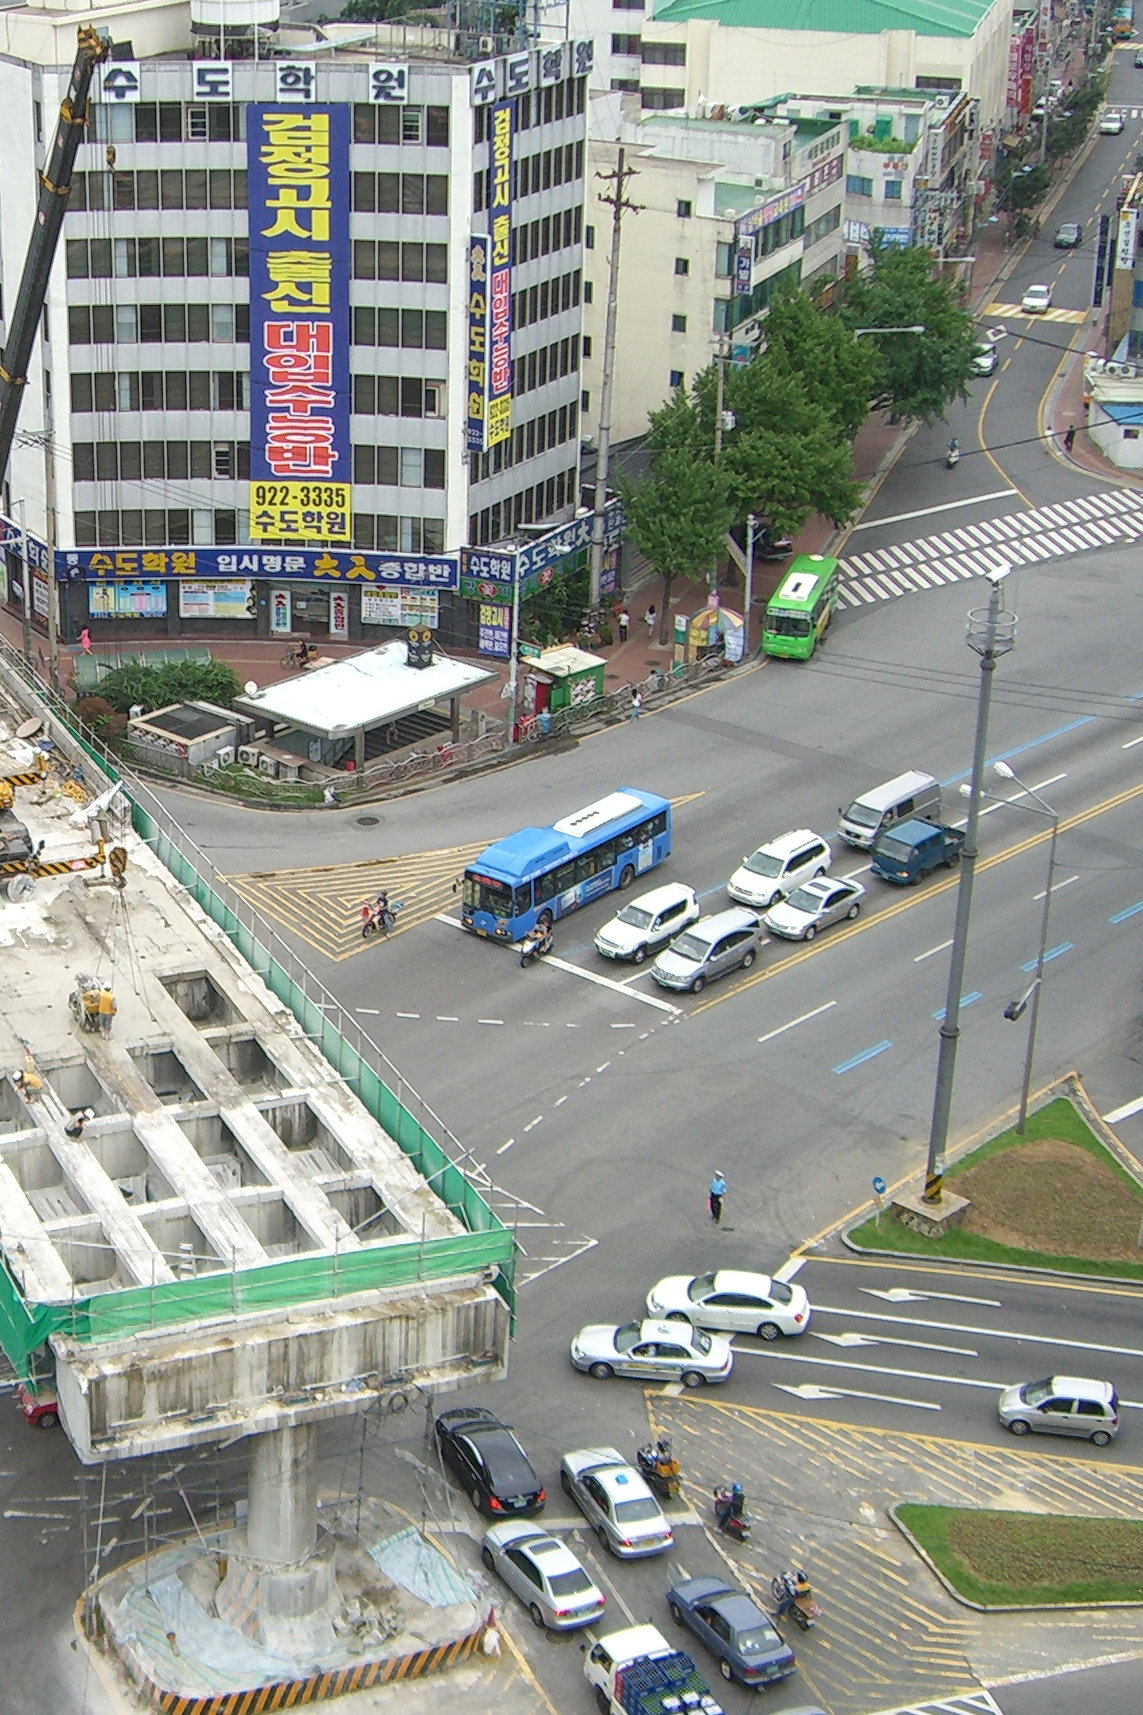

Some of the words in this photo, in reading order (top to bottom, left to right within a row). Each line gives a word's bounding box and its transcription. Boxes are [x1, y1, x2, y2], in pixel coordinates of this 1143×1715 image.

[103, 65, 406, 101] 수도학원
[475, 38, 594, 101] 수도학원
[260, 112, 332, 241] 검정고시
[493, 107, 511, 208] 검정고시
[492, 214, 510, 265] 출신
[260, 250, 332, 314] 출신
[468, 291, 486, 420] 수도학원
[492, 269, 511, 395] 대입수능반
[262, 320, 337, 478] 대입수능반
[255, 485, 346, 508] 922-3335
[255, 509, 347, 538] 수도학원
[89, 551, 197, 576] 수도학원
[217, 553, 306, 574] 입시명문
[470, 554, 512, 582] 수도학원
